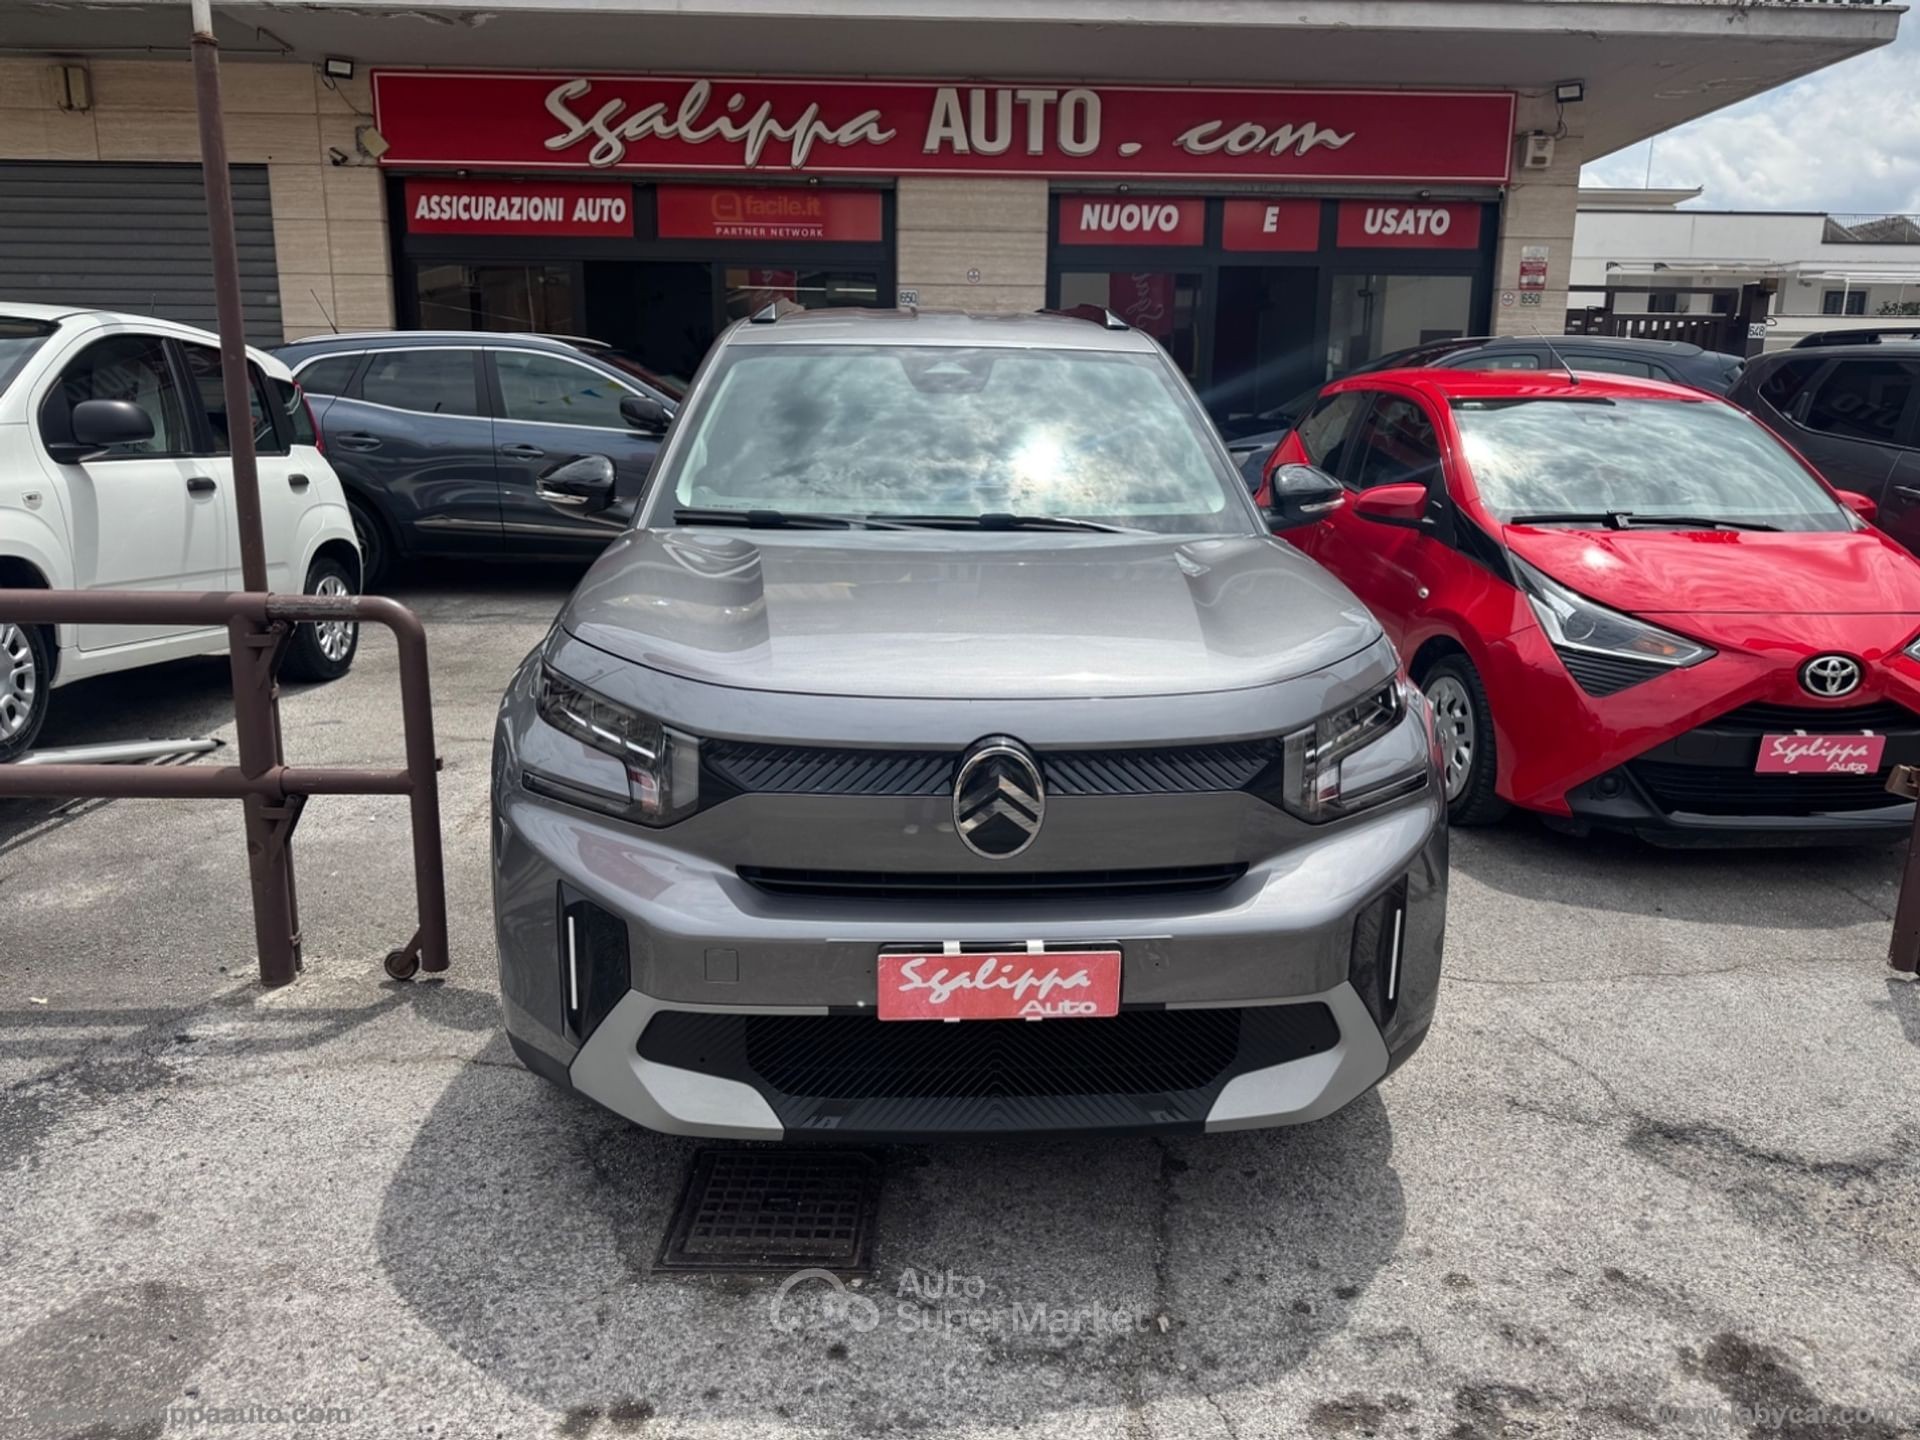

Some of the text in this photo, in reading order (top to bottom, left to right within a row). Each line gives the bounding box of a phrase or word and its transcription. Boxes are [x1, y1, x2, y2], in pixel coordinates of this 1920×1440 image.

[544, 78, 897, 168] Sgalippa
[922, 87, 1102, 157] AUTO
[414, 195, 626, 224] ASSICURAZIONI AUTO
[1080, 203, 1179, 233] NUOVO
[1263, 205, 1279, 233] E
[1364, 207, 1451, 236] USATO
[715, 227, 824, 238] PARTNER NETWORK
[1770, 736, 1869, 764] Sgalippa
[899, 957, 1092, 1004] Sgalippa
[1019, 1000, 1098, 1015] Auto
